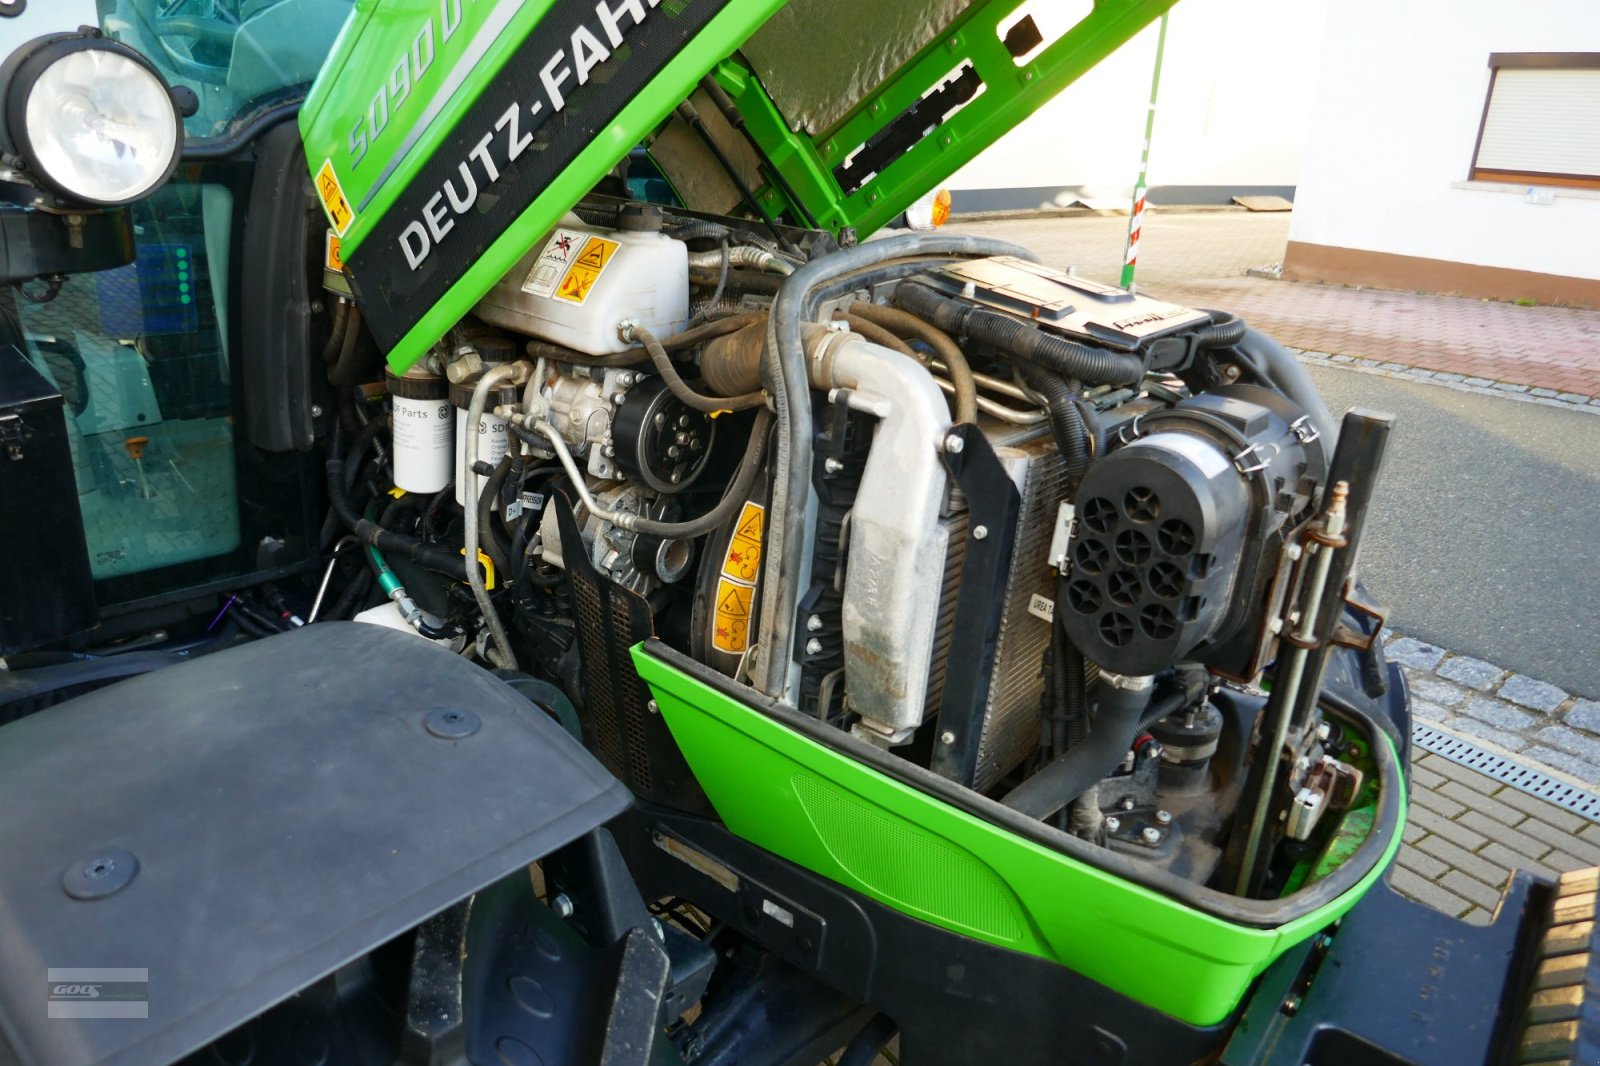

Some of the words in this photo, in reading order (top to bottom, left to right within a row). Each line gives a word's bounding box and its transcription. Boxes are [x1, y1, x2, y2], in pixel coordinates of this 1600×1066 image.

[399, 0, 662, 272] DEUTZ-FAH
[402, 407, 429, 419] Parts
[1033, 599, 1047, 613] UREA
